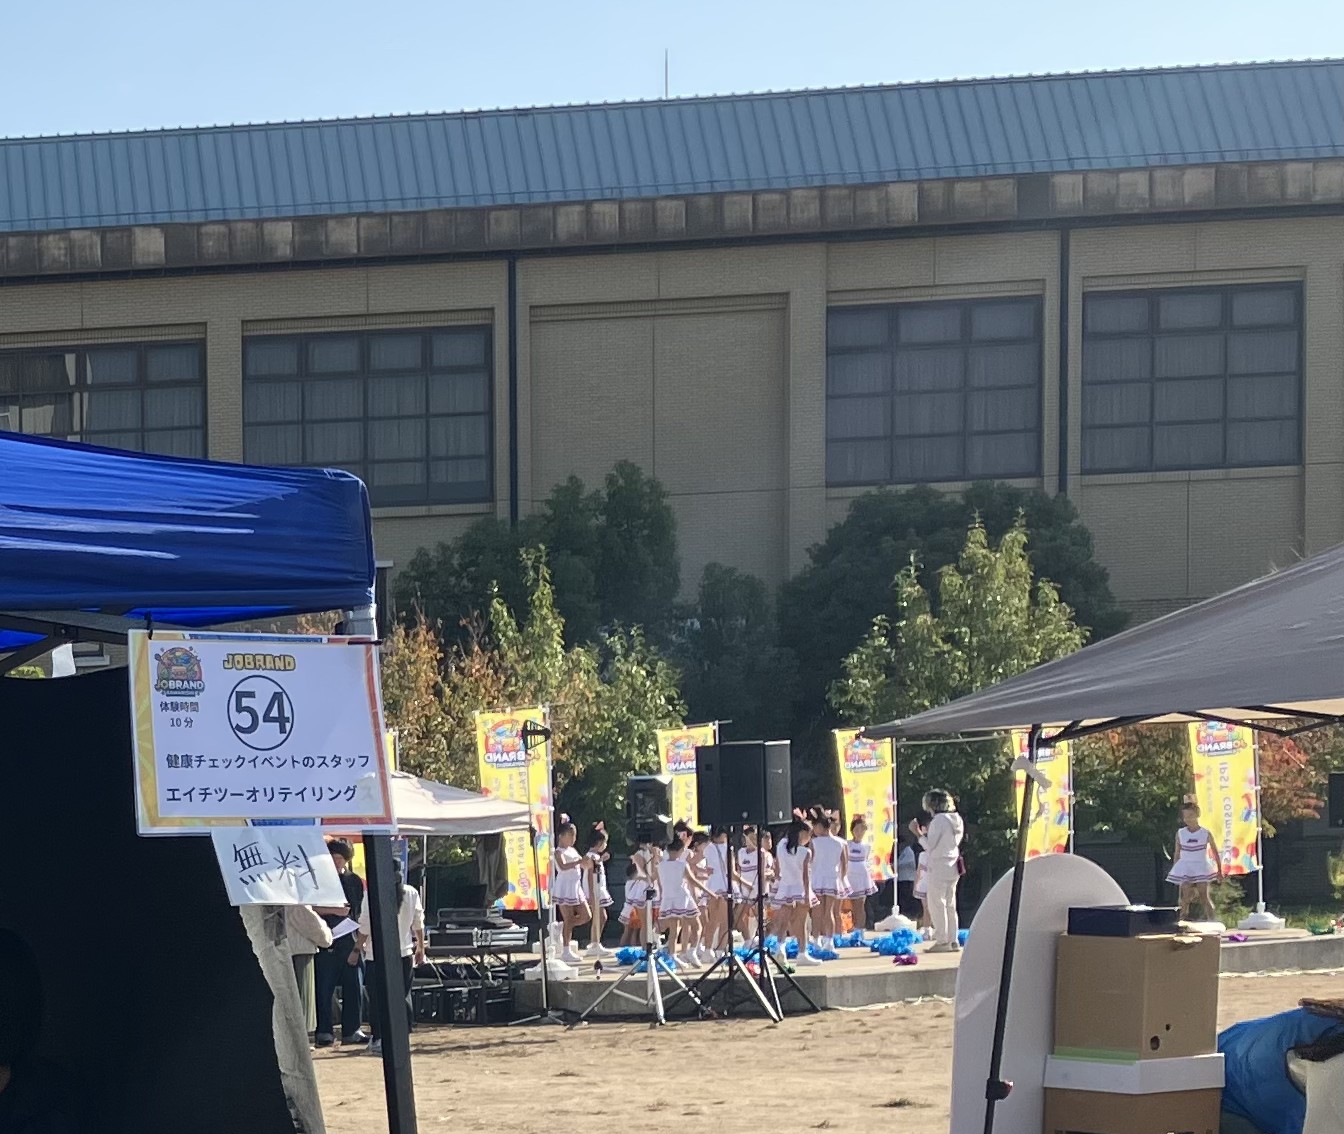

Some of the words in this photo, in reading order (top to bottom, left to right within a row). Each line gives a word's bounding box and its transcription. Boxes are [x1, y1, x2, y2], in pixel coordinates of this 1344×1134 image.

[223, 653, 296, 671] JOBRAND
[155, 679, 205, 693] JOBRAND
[160, 701, 200, 713] 体験時間
[234, 691, 291, 734] 54
[170, 717, 182, 728] 10
[184, 716, 194, 729] 分
[166, 754, 370, 770] 健康チェックイベントのスタッフ
[166, 786, 358, 803] エイチツーオリテイリング
[233, 841, 320, 890] 無料
